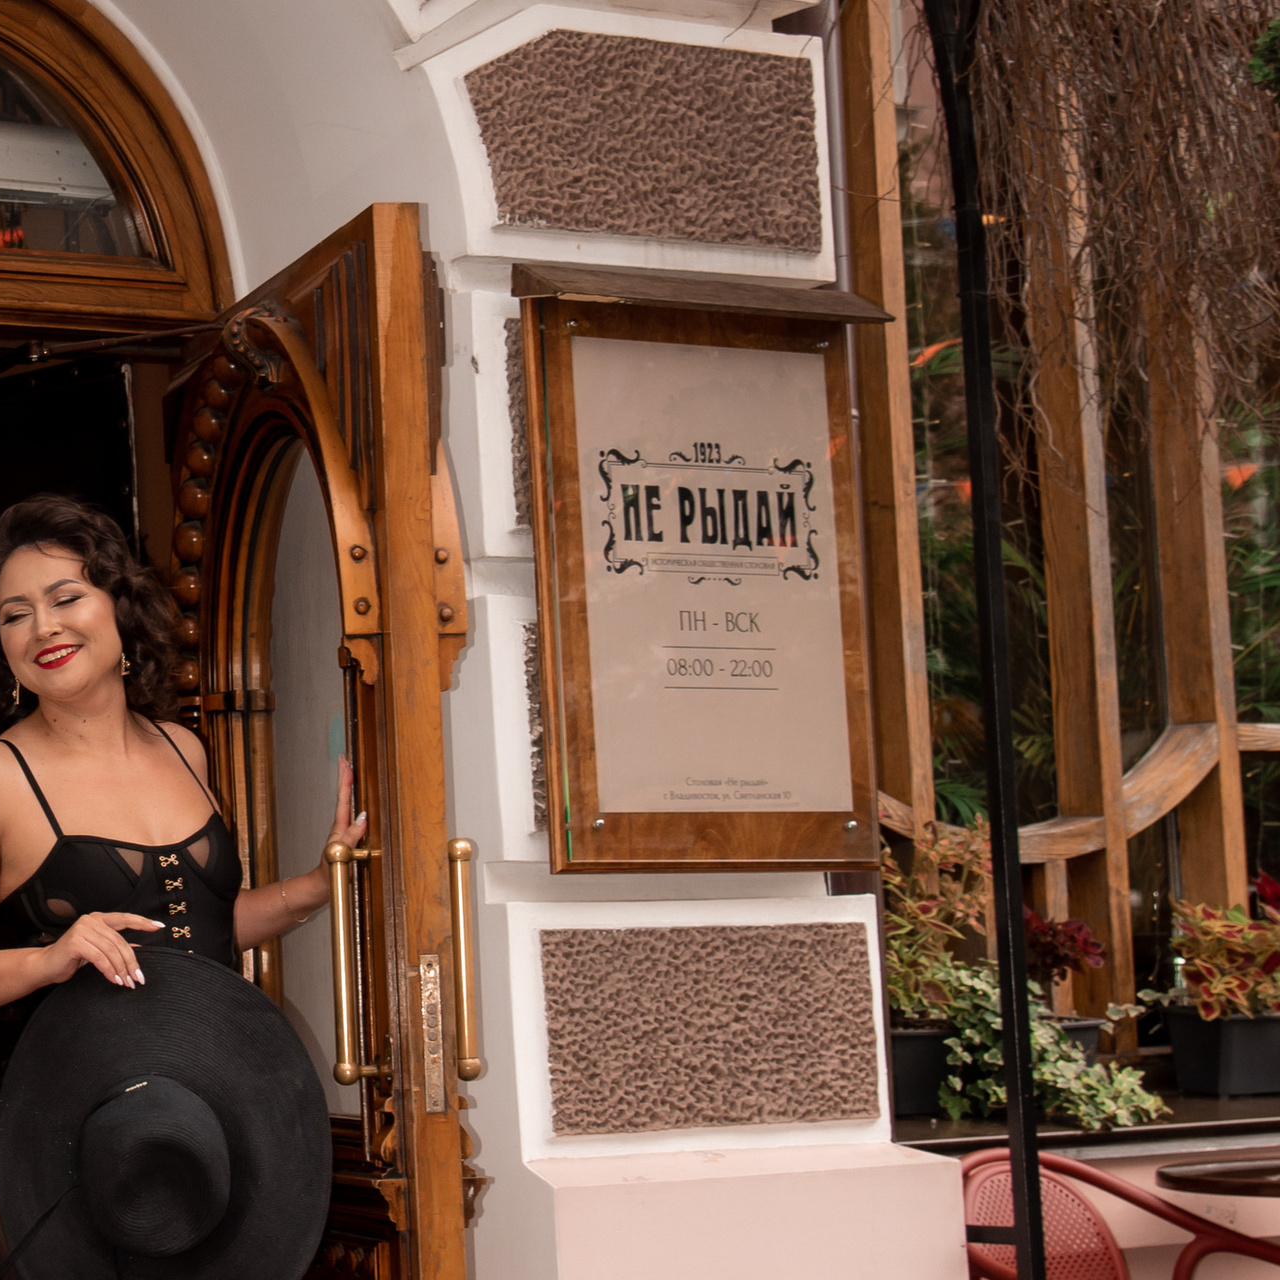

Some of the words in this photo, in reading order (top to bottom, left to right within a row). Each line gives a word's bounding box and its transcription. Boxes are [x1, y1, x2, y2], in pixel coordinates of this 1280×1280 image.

[693, 442, 721, 463] 1923
[621, 484, 663, 542] НЕ
[678, 484, 798, 551] РЫДАЙ
[679, 610, 706, 631] ПН
[725, 611, 761, 632] ВСК
[667, 658, 714, 676] 08:00
[730, 659, 774, 677] 22:00
